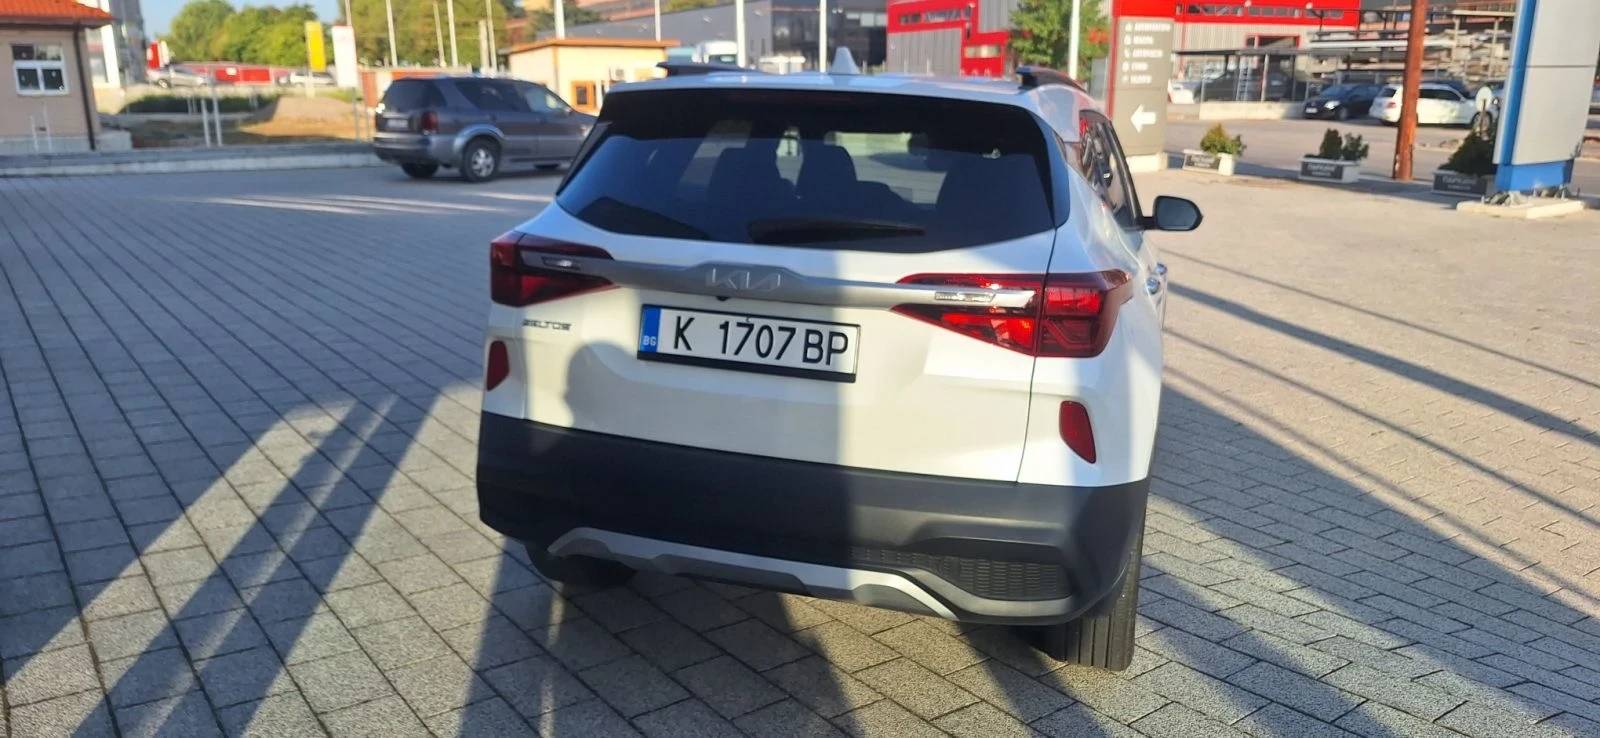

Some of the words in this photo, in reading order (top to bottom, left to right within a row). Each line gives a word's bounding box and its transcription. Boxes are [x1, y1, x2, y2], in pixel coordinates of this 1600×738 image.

[705, 267, 783, 292] KIA
[643, 335, 657, 347] BG
[673, 315, 695, 351] K
[719, 320, 797, 361] 1707
[802, 328, 849, 366] BP
